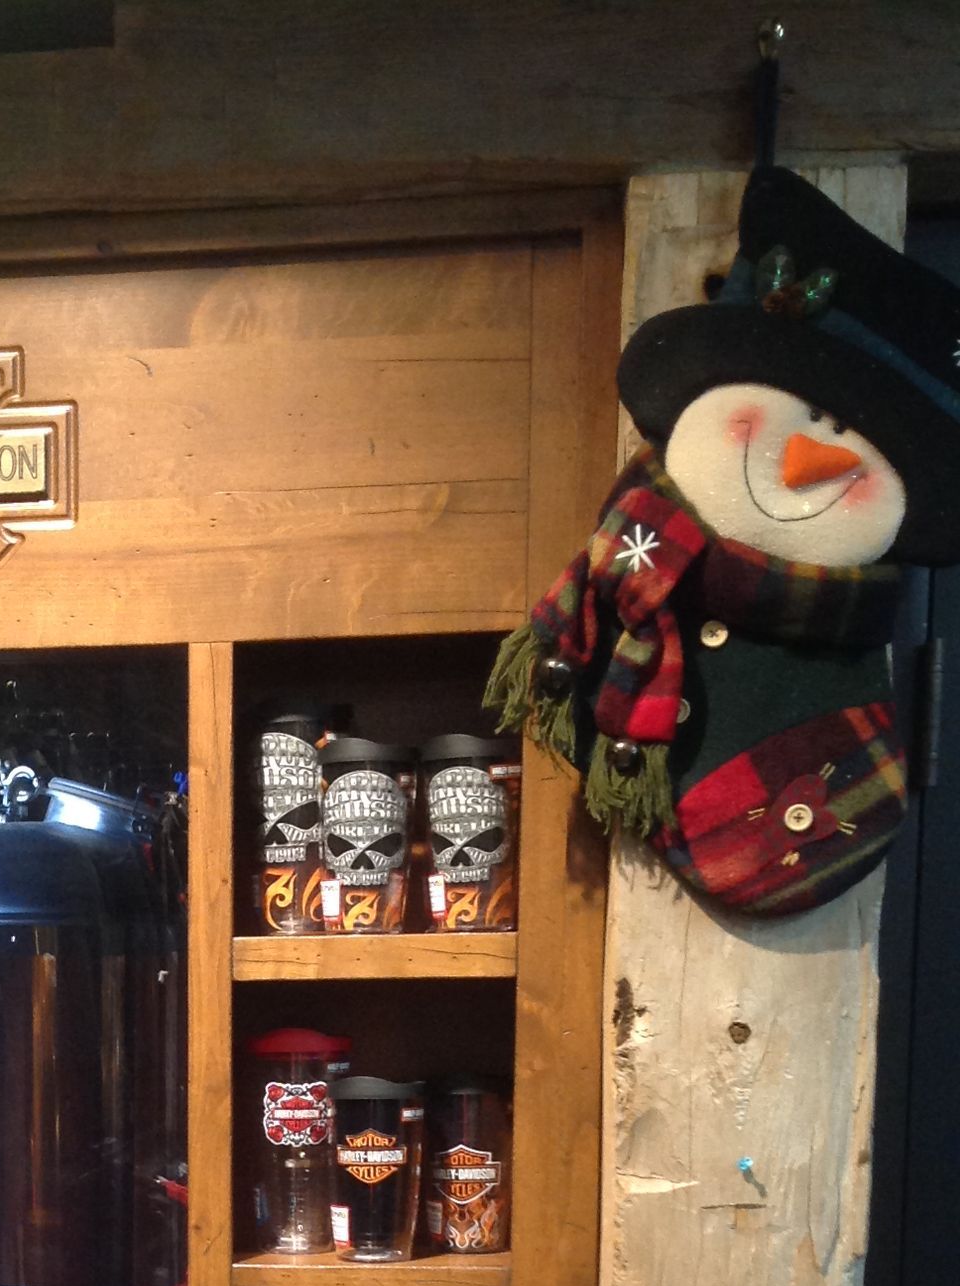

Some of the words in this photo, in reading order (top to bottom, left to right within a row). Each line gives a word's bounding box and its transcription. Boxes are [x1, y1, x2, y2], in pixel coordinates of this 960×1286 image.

[353, 1134, 389, 1147] MOTOR
[450, 1154, 482, 1165] OTOR
[353, 1166, 389, 1180] CYCLES
[451, 1183, 481, 1197] YCLES
